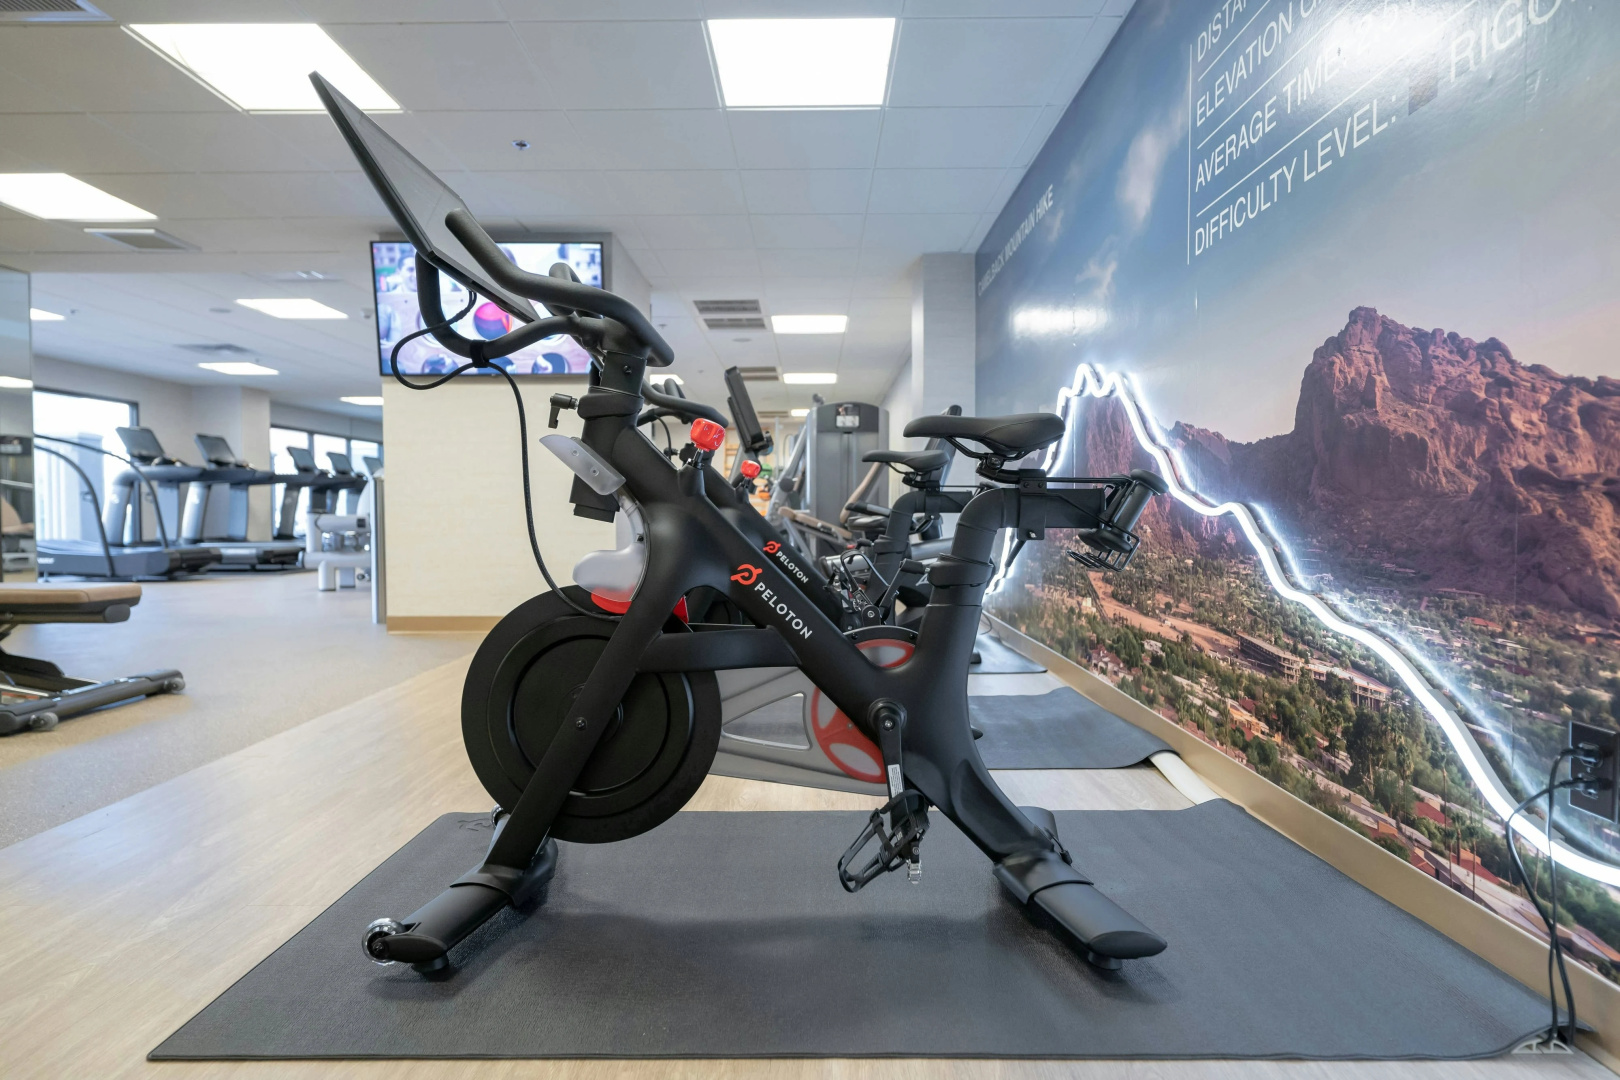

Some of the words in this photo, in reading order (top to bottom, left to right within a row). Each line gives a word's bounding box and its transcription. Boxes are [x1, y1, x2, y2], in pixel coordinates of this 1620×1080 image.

[1196, 1, 1293, 128] ELEVATION
[1197, 0, 1246, 63] DISTA
[1195, 94, 1277, 193] AVERAGE
[1195, 156, 1298, 257] DIFFICULTY
[1303, 94, 1397, 183] LEVEL:
[1004, 208, 1035, 262] MOUNTAIN
[1035, 183, 1054, 223] HIKE
[776, 550, 809, 583] PELOTON
[754, 581, 813, 640] PELOTON
